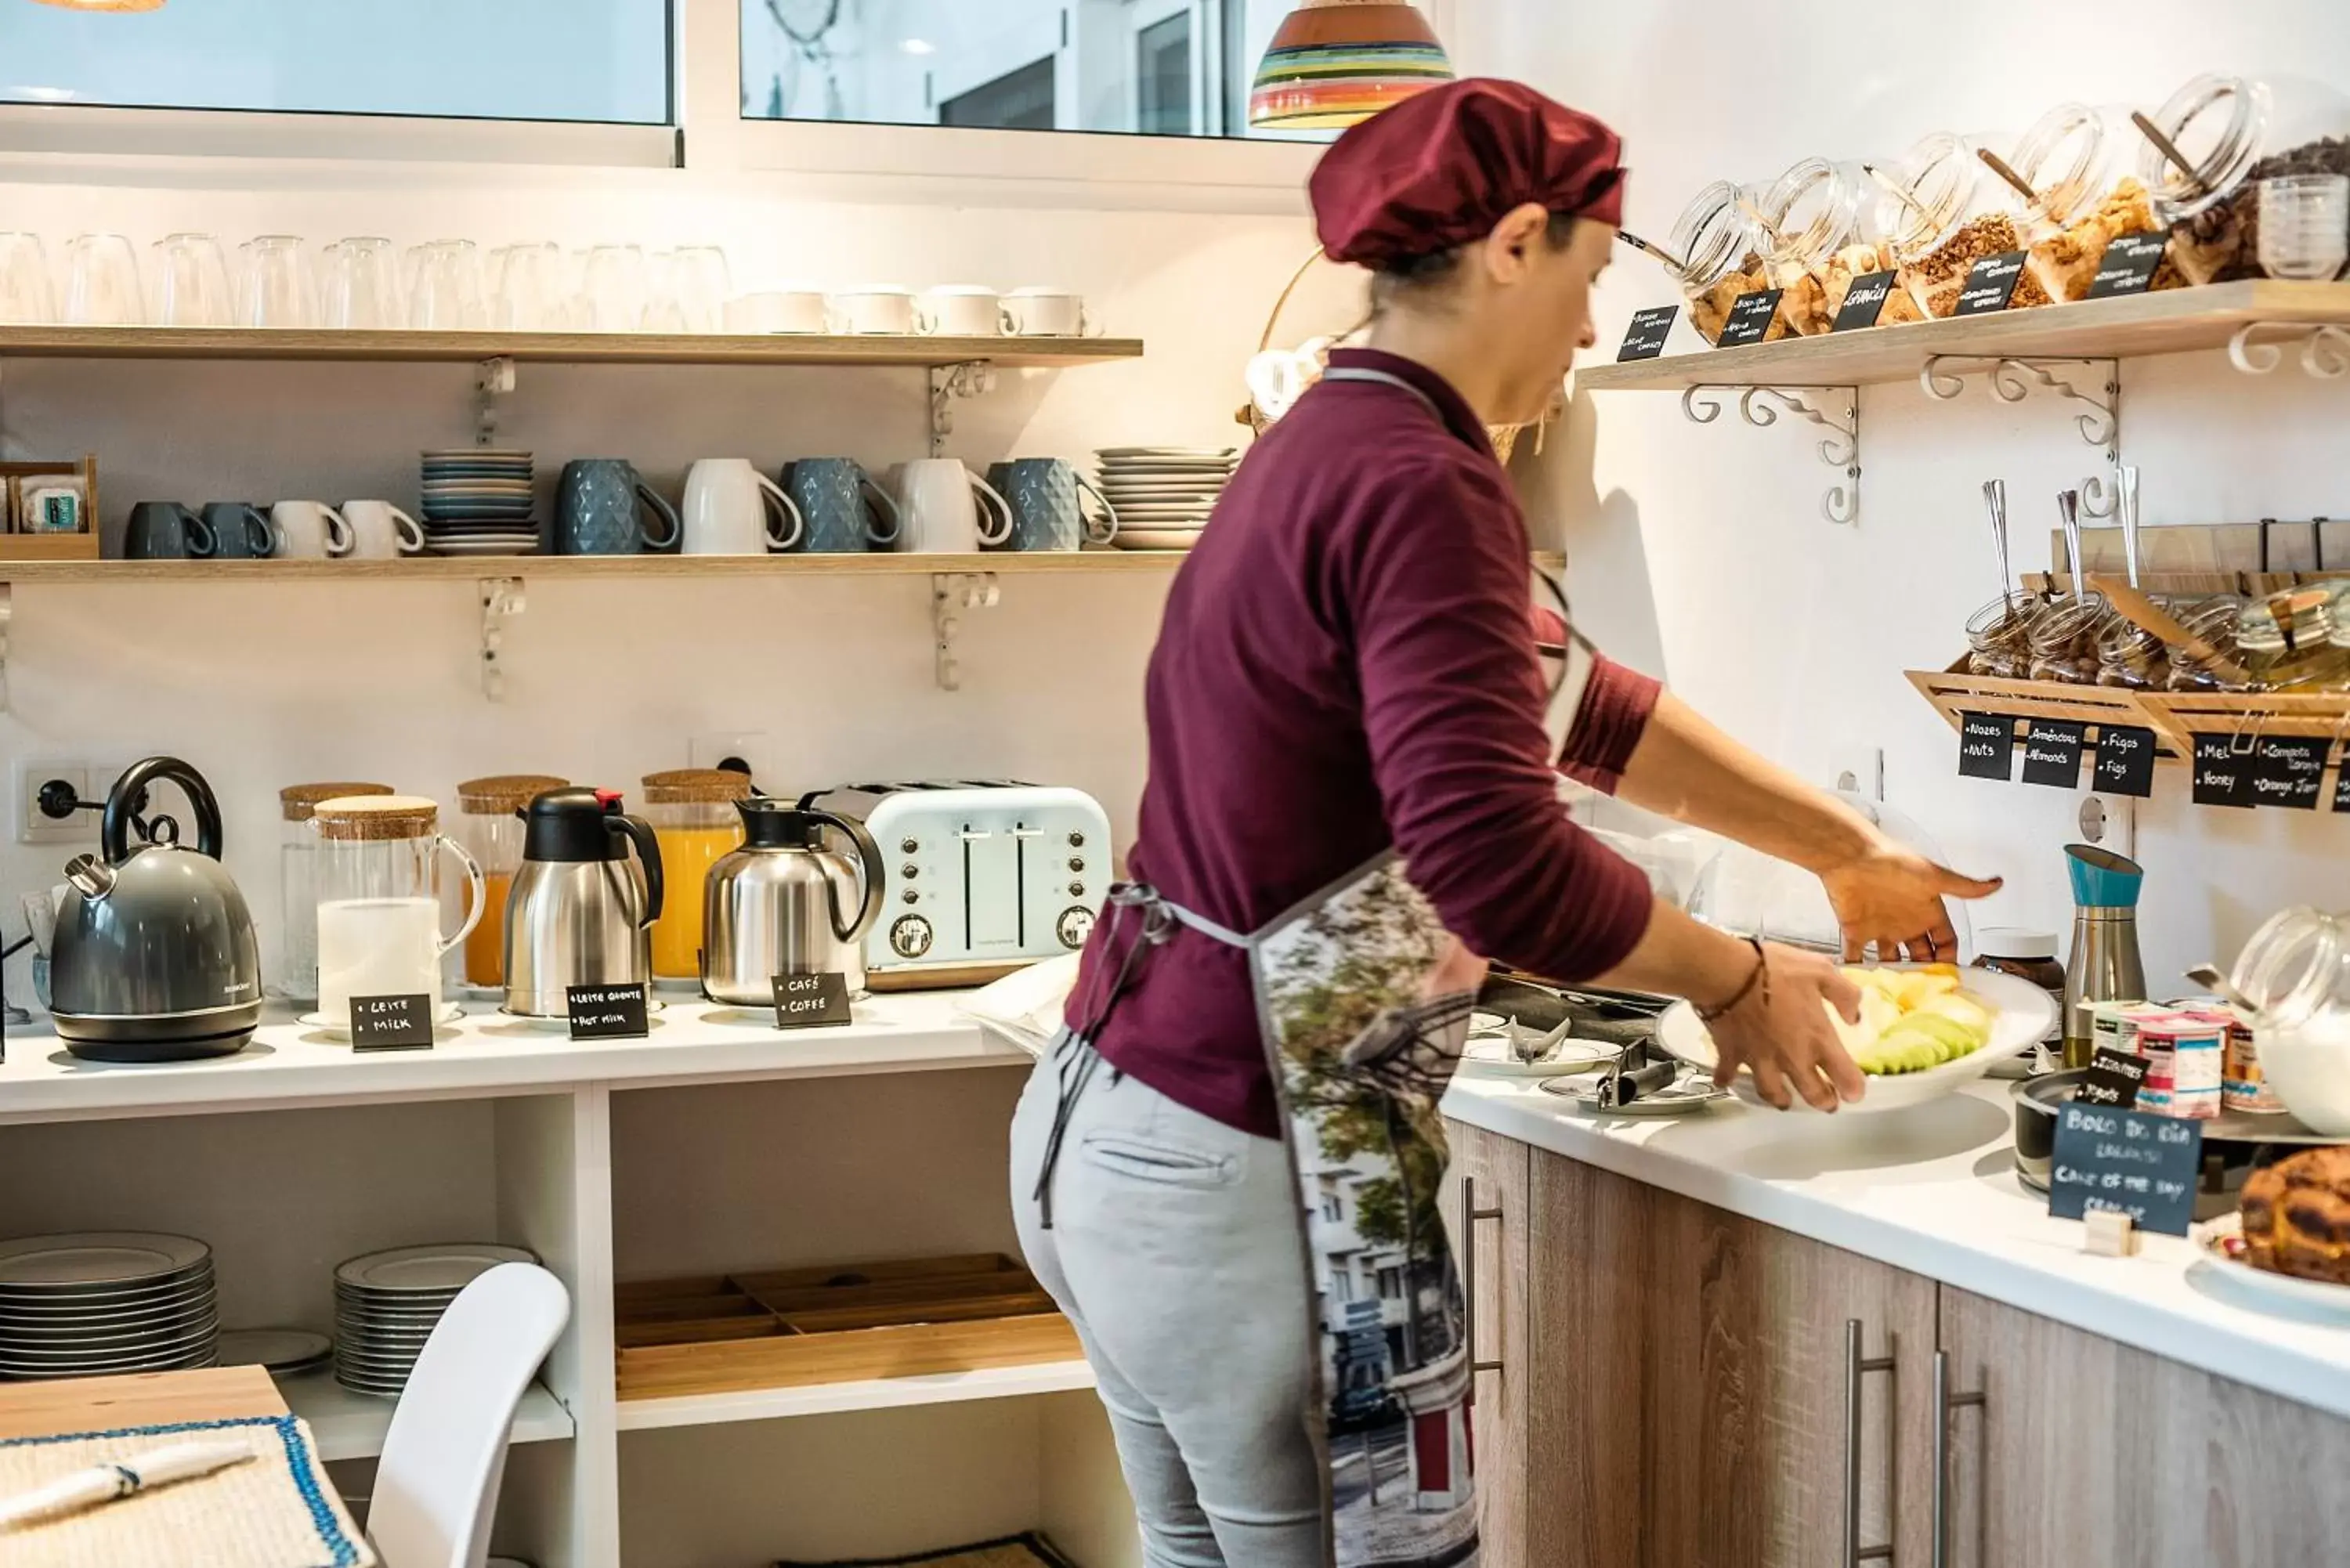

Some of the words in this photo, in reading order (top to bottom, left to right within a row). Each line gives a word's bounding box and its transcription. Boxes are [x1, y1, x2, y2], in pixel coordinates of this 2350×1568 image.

[1970, 723, 2001, 737] Nozes
[1969, 742, 1994, 756] Nuts
[2110, 733, 2138, 754] Figos
[2204, 744, 2230, 759] Mel
[2106, 761, 2128, 779] Figs
[2203, 770, 2235, 793] Honey
[789, 975, 819, 991] CAFÉ
[576, 993, 604, 1003] LEITE
[371, 999, 408, 1013] LEITE
[2066, 1109, 2117, 1134] BOLO
